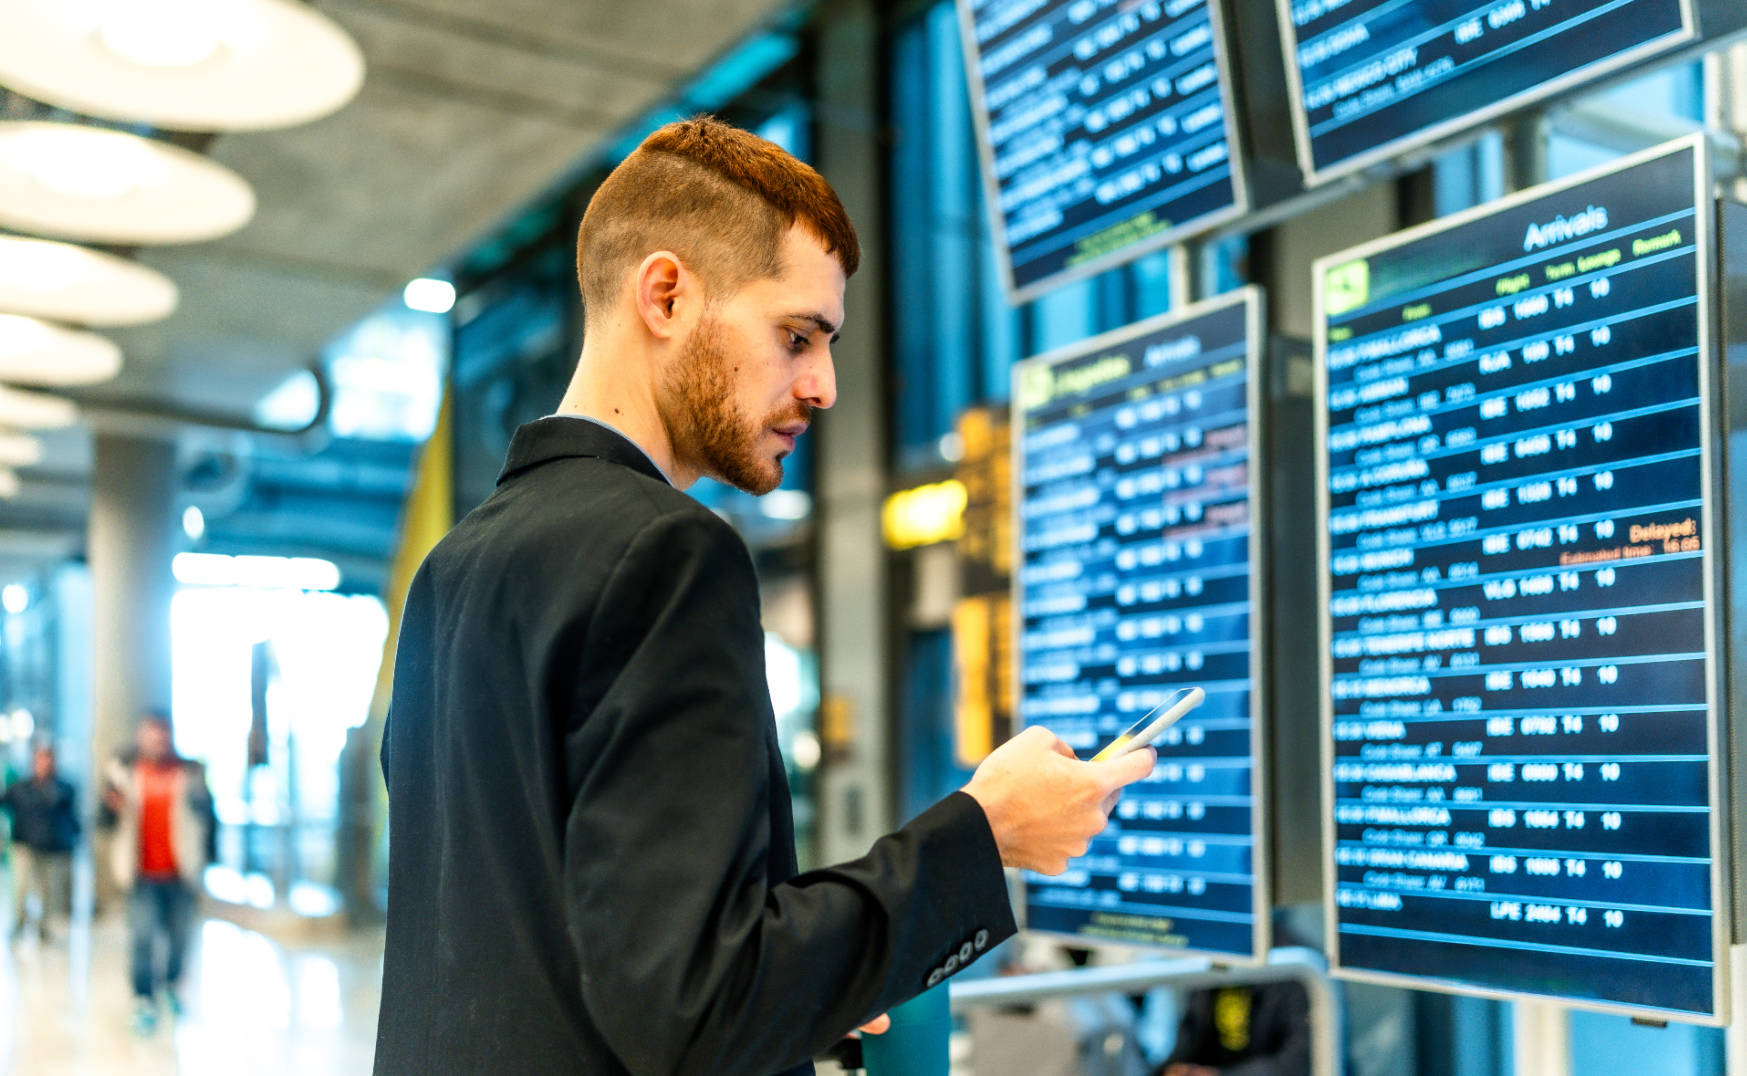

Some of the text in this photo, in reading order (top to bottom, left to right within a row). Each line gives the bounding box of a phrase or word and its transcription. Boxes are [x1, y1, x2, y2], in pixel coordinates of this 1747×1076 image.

[1524, 204, 1608, 252] Arrivals
[1591, 276, 1608, 297] 10
[1592, 325, 1609, 345] 10
[1593, 373, 1610, 393] 10
[1594, 421, 1611, 440] 10
[1595, 470, 1612, 489] 10
[1596, 518, 1613, 537] 10
[1630, 517, 1696, 543] Delayed:
[1597, 567, 1614, 585] 10
[1598, 616, 1615, 634] 10
[1599, 665, 1617, 682] 10
[1600, 714, 1618, 730] 10
[1601, 763, 1619, 779] 10
[1603, 811, 1620, 828] 10
[1604, 860, 1621, 878] 10
[1605, 909, 1622, 927] 10
